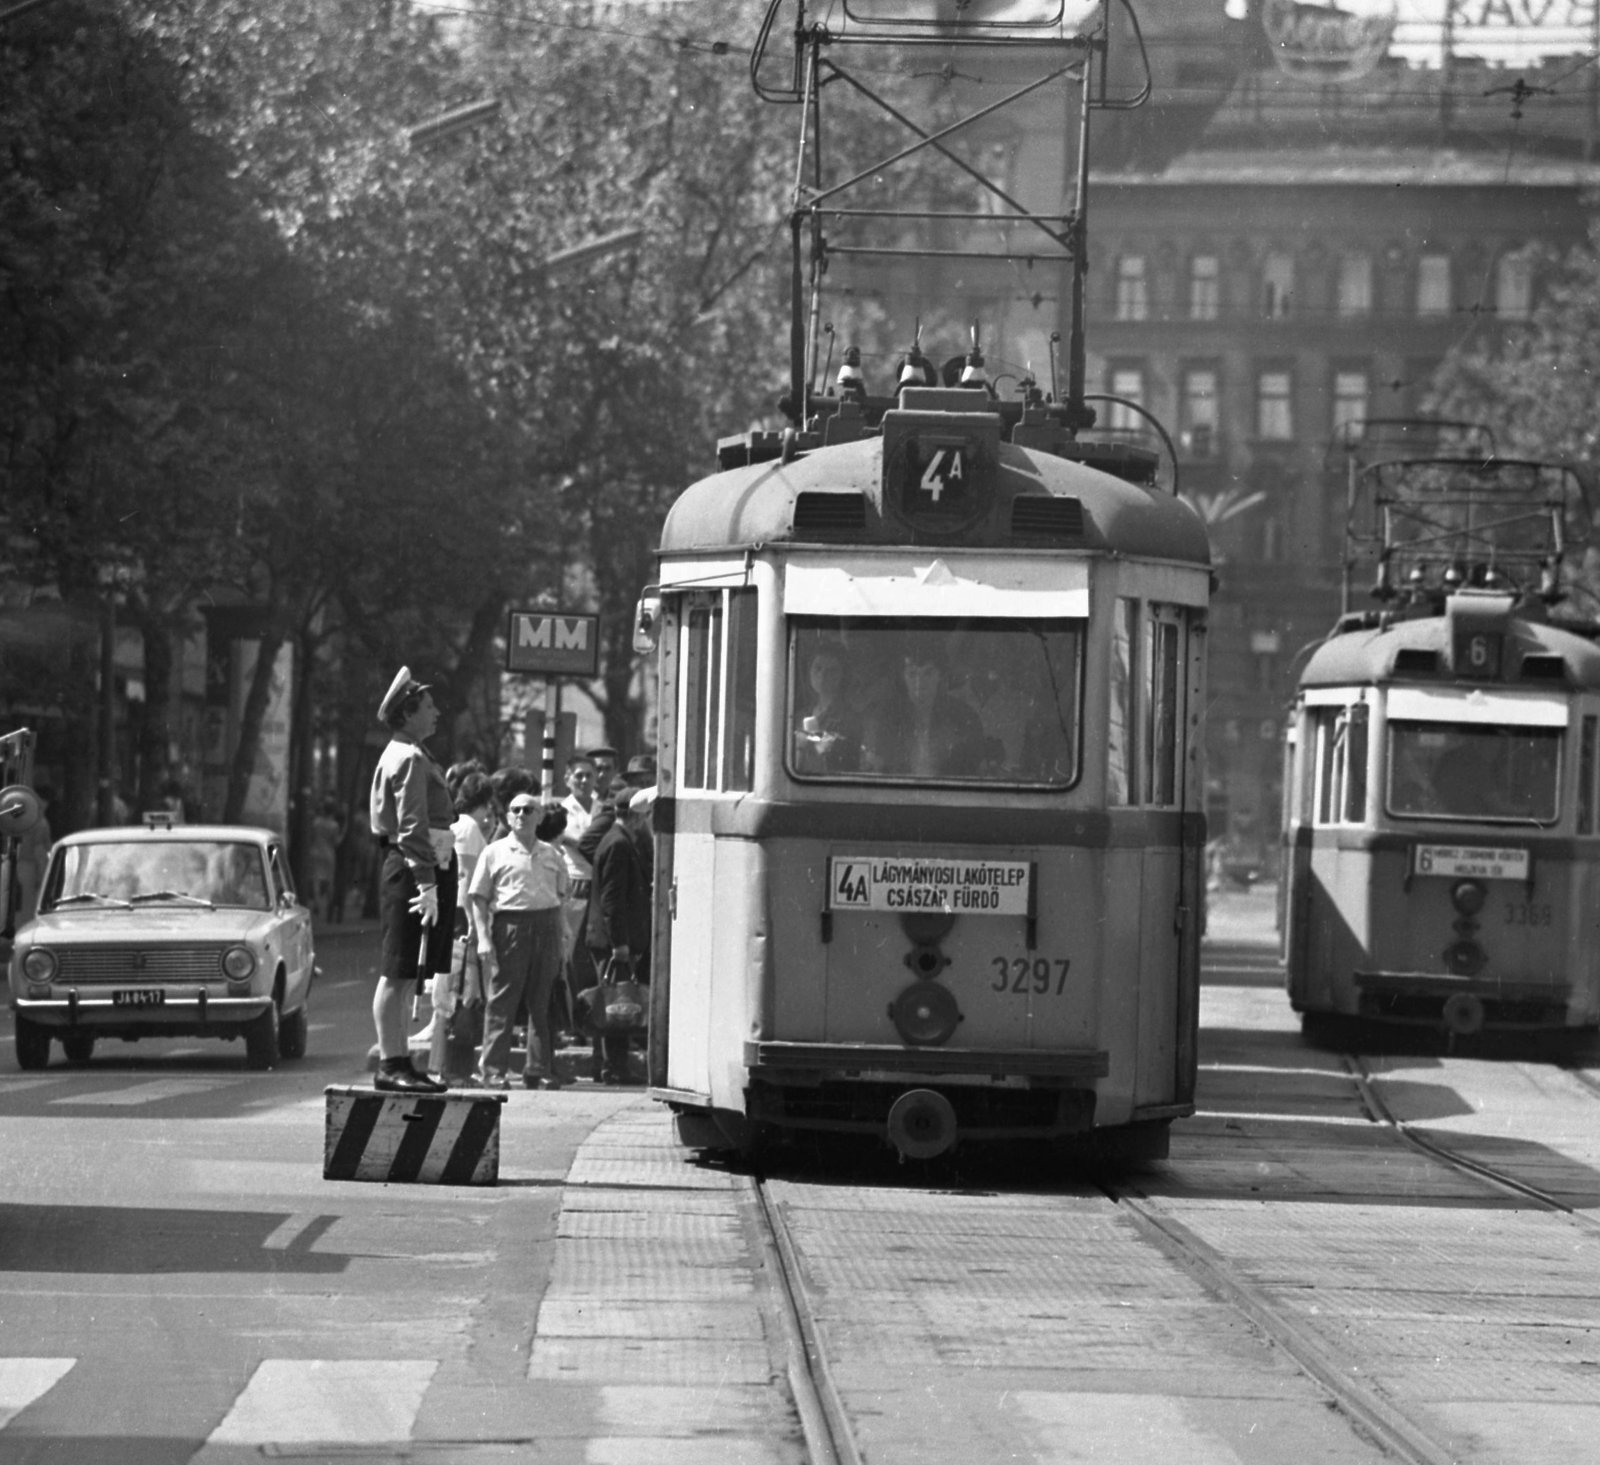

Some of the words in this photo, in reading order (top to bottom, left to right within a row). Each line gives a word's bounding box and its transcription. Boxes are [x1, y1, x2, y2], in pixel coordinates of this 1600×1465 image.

[920, 450, 963, 502] 4A
[518, 616, 588, 651] MM
[1470, 635, 1487, 667] 6
[872, 861, 955, 885] LÁGYMÁNYOSI
[956, 862, 1026, 887] LAKÓTELEP
[1420, 849, 1433, 872] 6
[837, 864, 868, 902] 4A
[887, 884, 949, 908] CSÁSZÁR
[991, 956, 1071, 996] 3297
